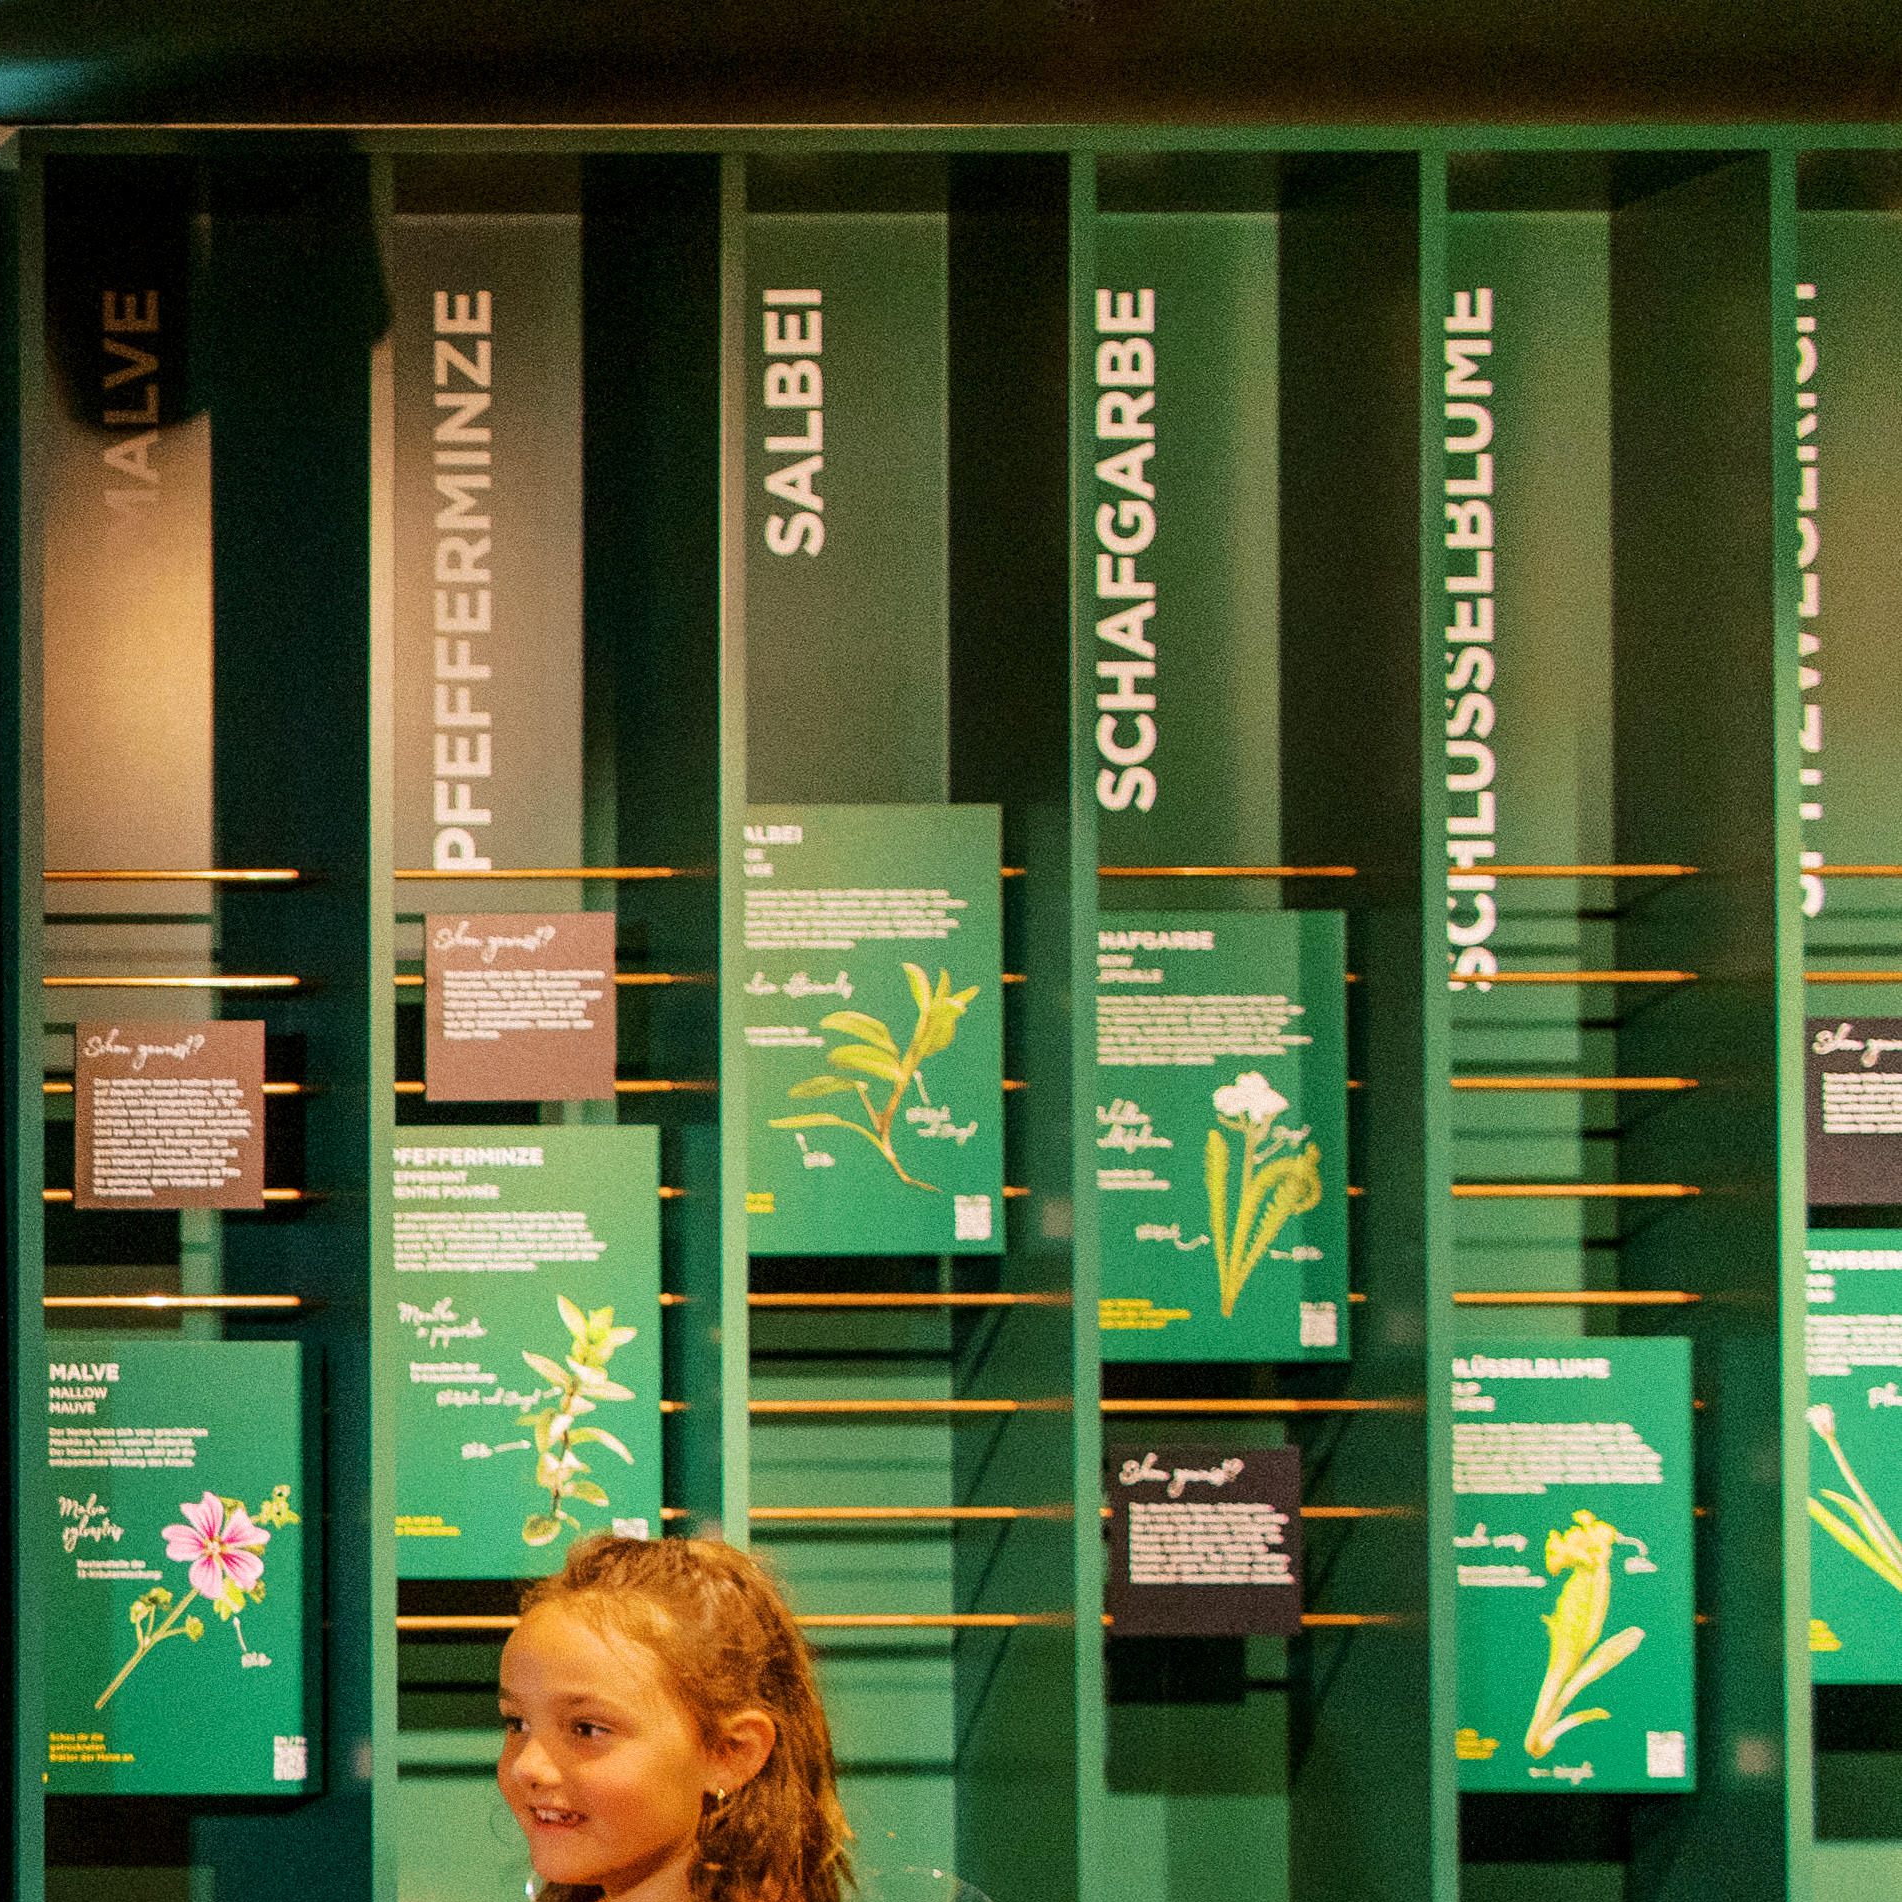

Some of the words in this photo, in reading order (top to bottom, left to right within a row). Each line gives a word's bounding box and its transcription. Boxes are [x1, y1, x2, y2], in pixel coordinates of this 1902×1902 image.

[764, 288, 822, 557] SALBEI
[433, 291, 492, 871] PFEFFERMINZE
[1096, 288, 1157, 812] SCHAFGARBE
[49, 1363, 120, 1382] MALVE
[49, 1387, 107, 1399] MALLOW
[49, 1402, 96, 1414] MAUVE
